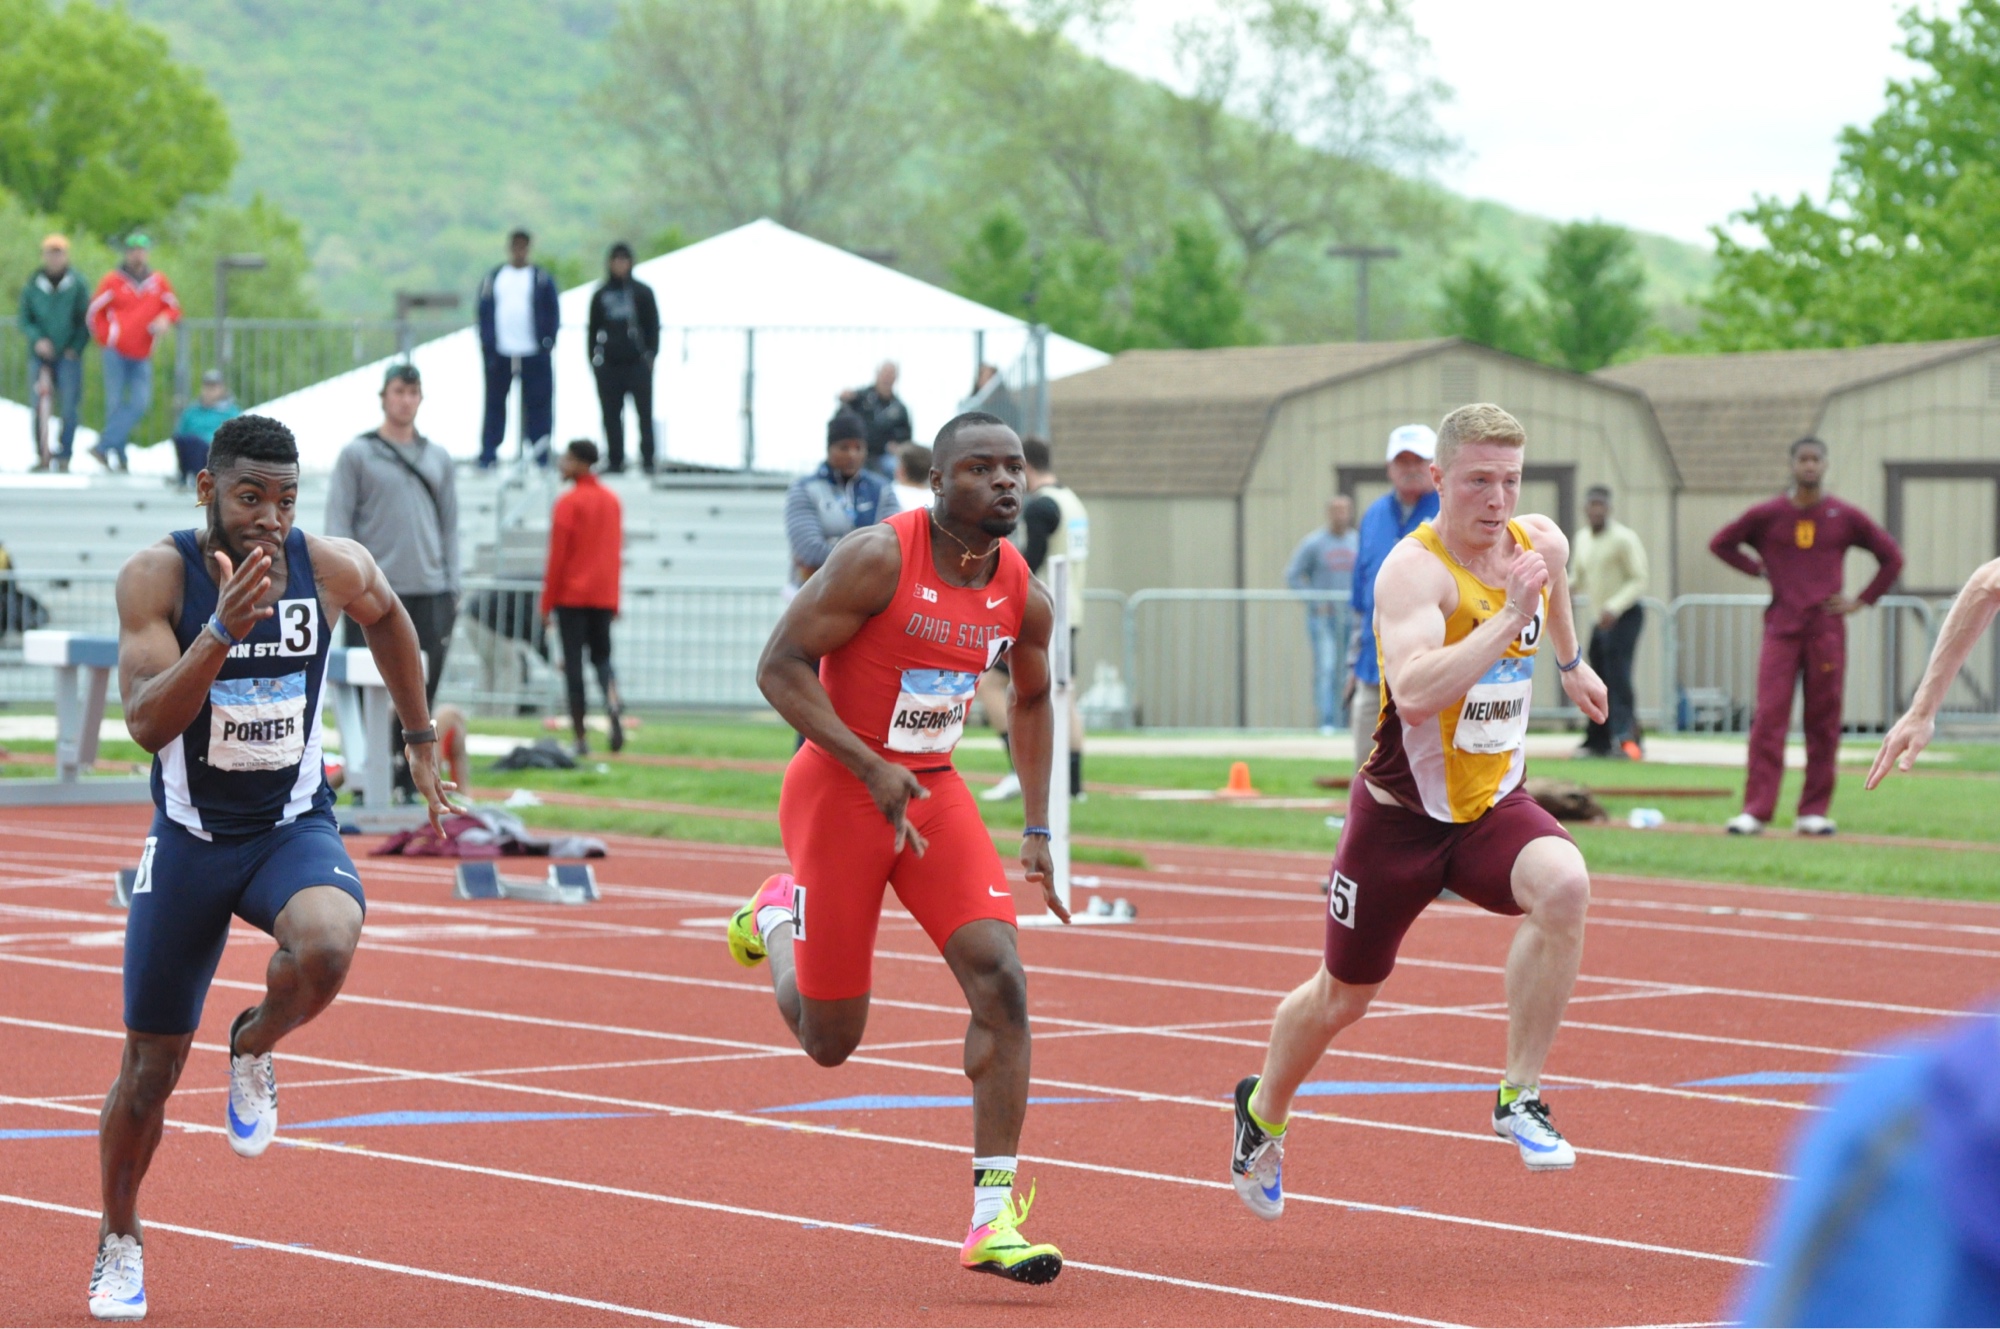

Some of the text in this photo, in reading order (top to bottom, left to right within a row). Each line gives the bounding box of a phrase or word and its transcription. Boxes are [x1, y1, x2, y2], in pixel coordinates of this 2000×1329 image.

[285, 603, 312, 653] 3
[905, 612, 951, 644] OHIO
[1464, 697, 1524, 721] NEUMANN
[223, 717, 295, 741] PORTER
[1333, 874, 1351, 920] 5
